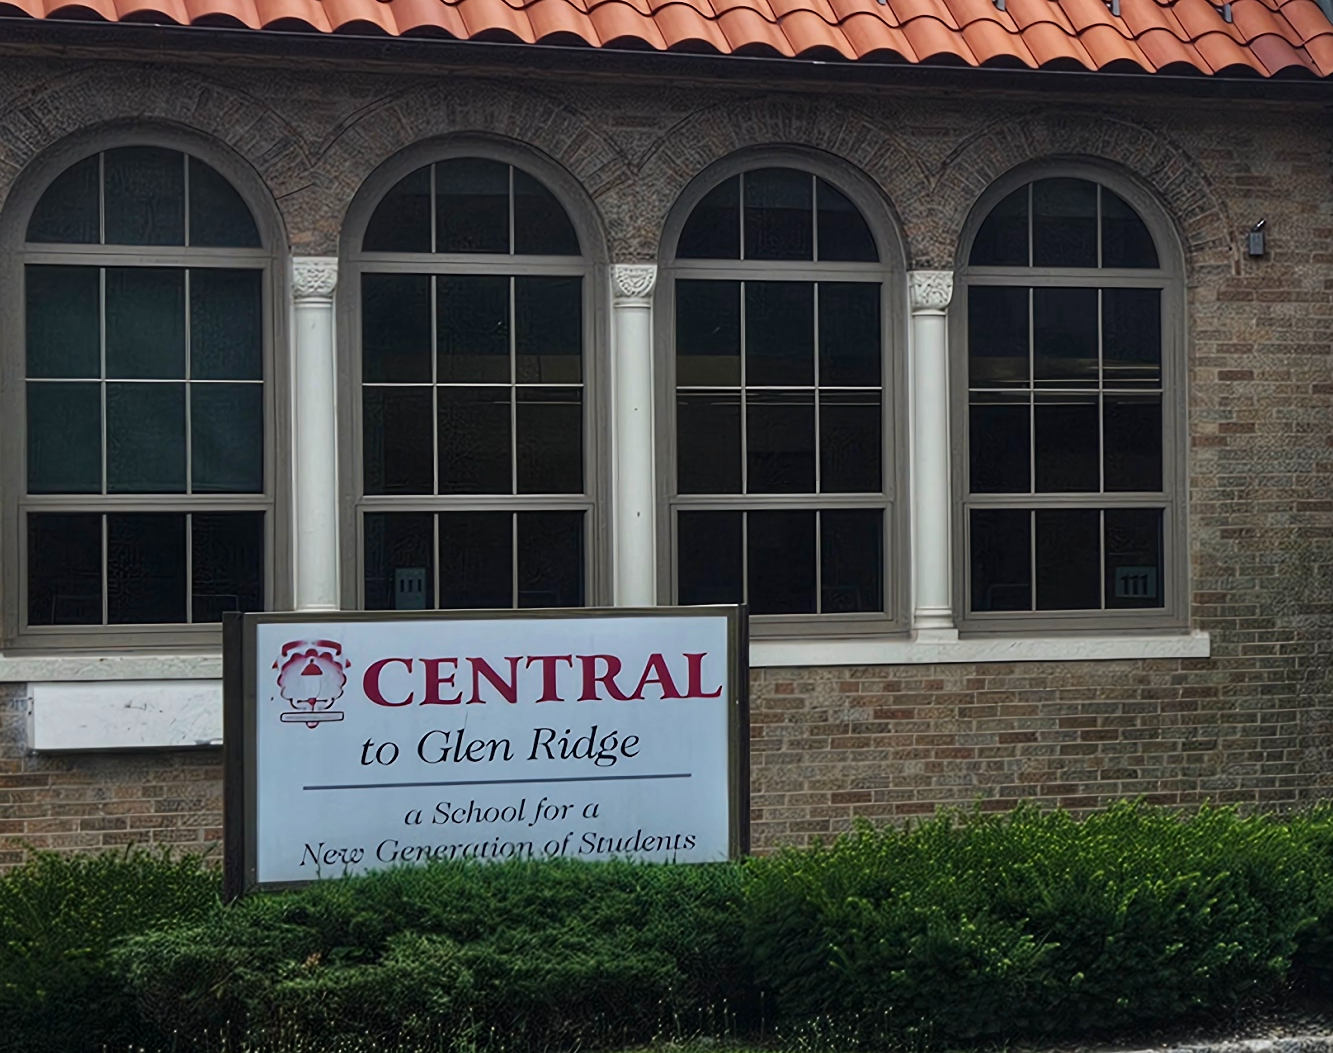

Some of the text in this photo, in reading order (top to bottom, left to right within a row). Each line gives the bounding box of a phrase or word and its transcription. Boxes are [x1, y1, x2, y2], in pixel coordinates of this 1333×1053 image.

[362, 652, 723, 707] CENTRAL
[360, 725, 641, 767] to Glen Ridge
[404, 797, 600, 827] a School for a
[300, 829, 696, 867] New Generation of Students
